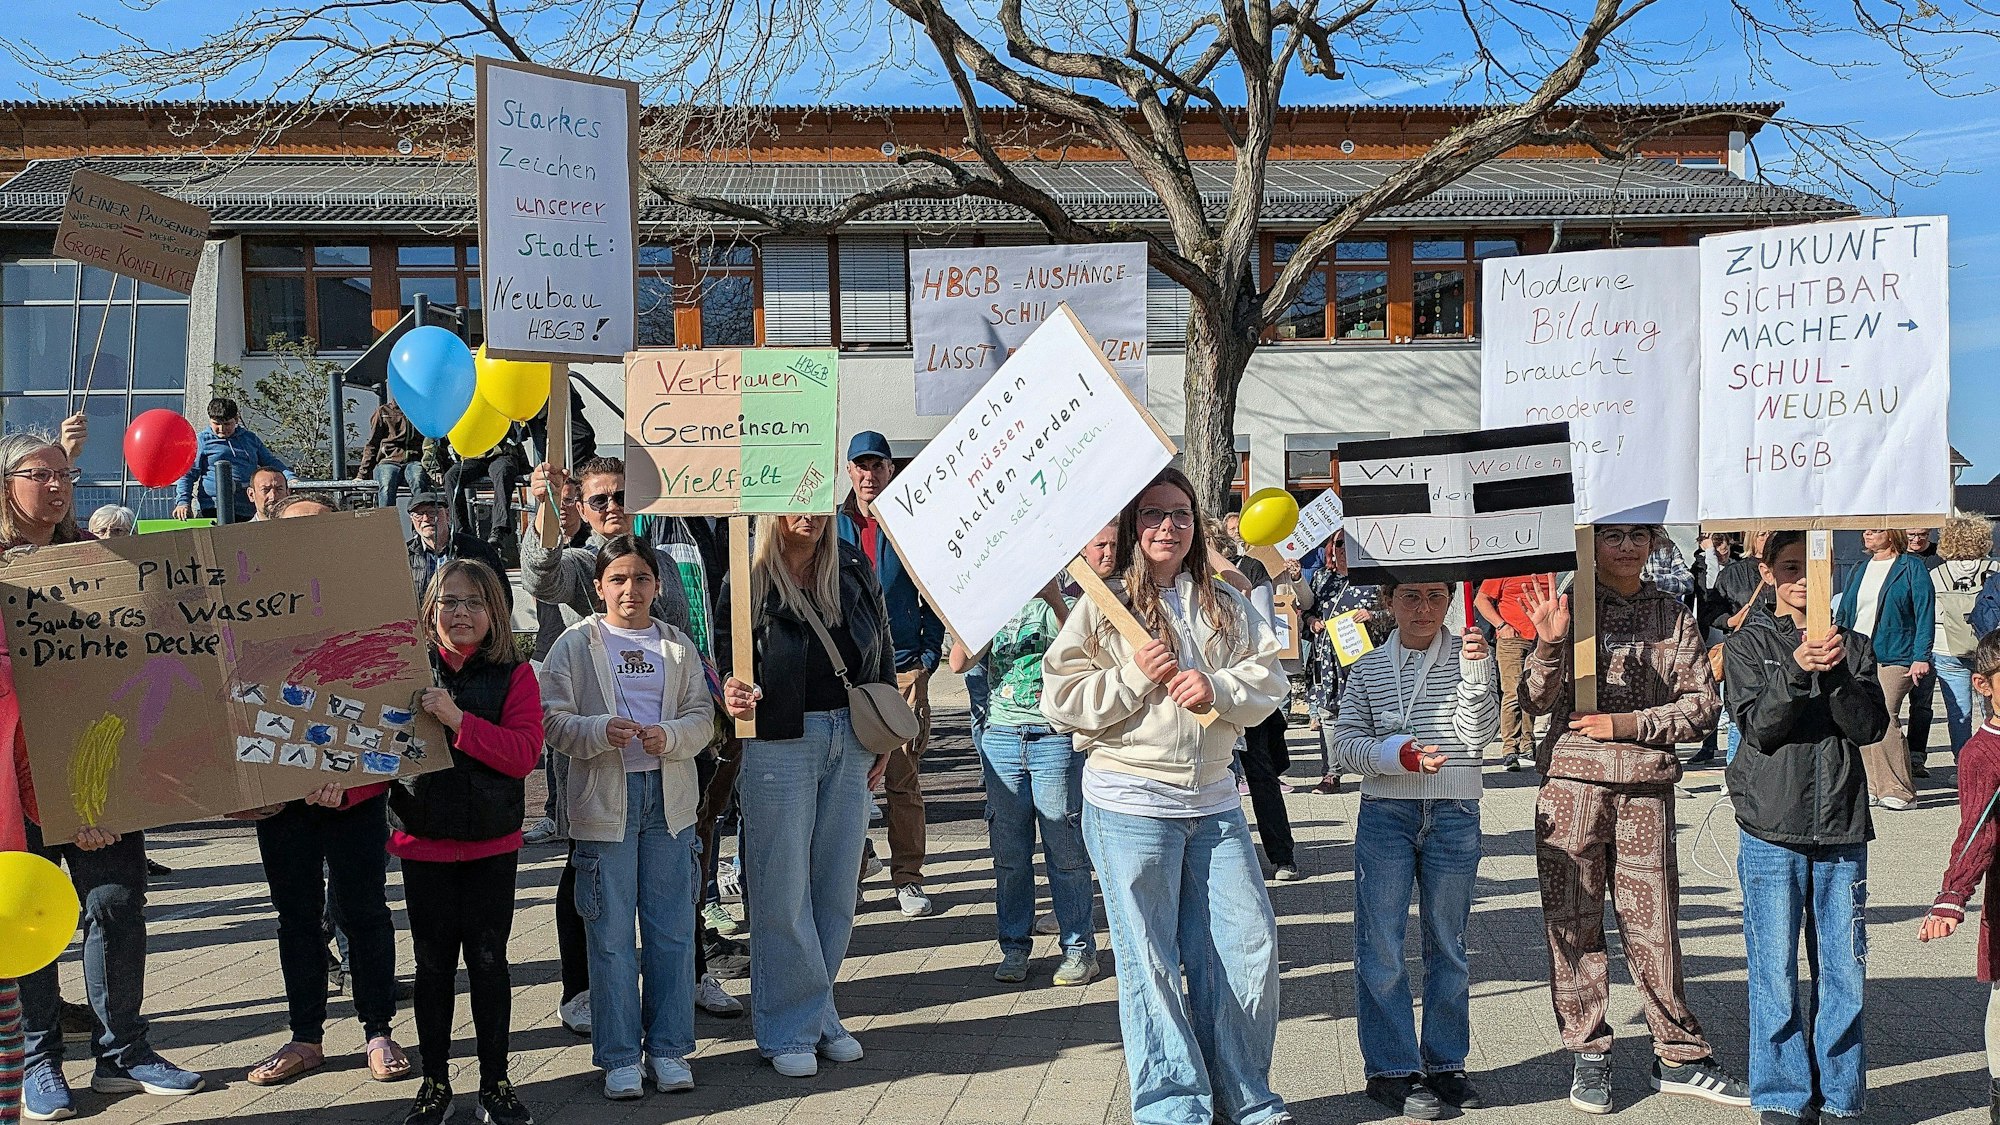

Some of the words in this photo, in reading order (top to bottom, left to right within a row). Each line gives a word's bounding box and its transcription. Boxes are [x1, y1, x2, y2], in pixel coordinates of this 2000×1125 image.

[497, 99, 601, 139] Starkes
[498, 146, 596, 181] Zeichen
[69, 184, 132, 221] KLEINER
[137, 204, 208, 240] PAUSENHOF
[515, 196, 606, 217] unserer
[518, 233, 614, 257] Stadt:
[1726, 223, 1930, 276] ZUKUNFT
[116, 244, 196, 291] KONFLIKTE
[921, 265, 1001, 301] HBGB
[1501, 265, 1635, 301] Moderne
[492, 276, 602, 311] Neubau
[528, 317, 610, 343] HBGB!
[989, 301, 1048, 326] SCHIL
[1525, 301, 1661, 351] Bildung
[1721, 312, 1882, 353] MACHEN
[656, 358, 799, 394] Vertrauen
[794, 354, 830, 382] HBGB
[926, 343, 997, 372] LASST
[1504, 347, 1633, 385] braucht
[1728, 357, 1850, 390] SCHUL-
[1525, 396, 1637, 424] moderne
[1757, 385, 1899, 421] NEUBAU
[640, 401, 810, 446] Gemeinsam
[894, 375, 1027, 518] Versprechen
[967, 418, 1026, 489] müssen
[1745, 441, 1833, 474] HBGB
[660, 464, 783, 496] Vielfalt
[1358, 462, 1432, 481] Wir
[1468, 454, 1562, 476] Wollen
[1324, 495, 1344, 521] Unsere
[1432, 486, 1472, 502] den
[946, 466, 1018, 559] gehalten
[1304, 511, 1320, 527] sind
[1315, 502, 1335, 526] Kinder
[949, 570, 973, 595] Wir
[974, 529, 1009, 570] warten
[1010, 493, 1034, 526] seit
[1030, 468, 1048, 496] 7
[1292, 531, 1310, 552] kunft
[27, 575, 105, 610] Mehr
[27, 605, 146, 638] Sauberes
[33, 635, 129, 667] Dichte
[617, 662, 655, 674] 1982
